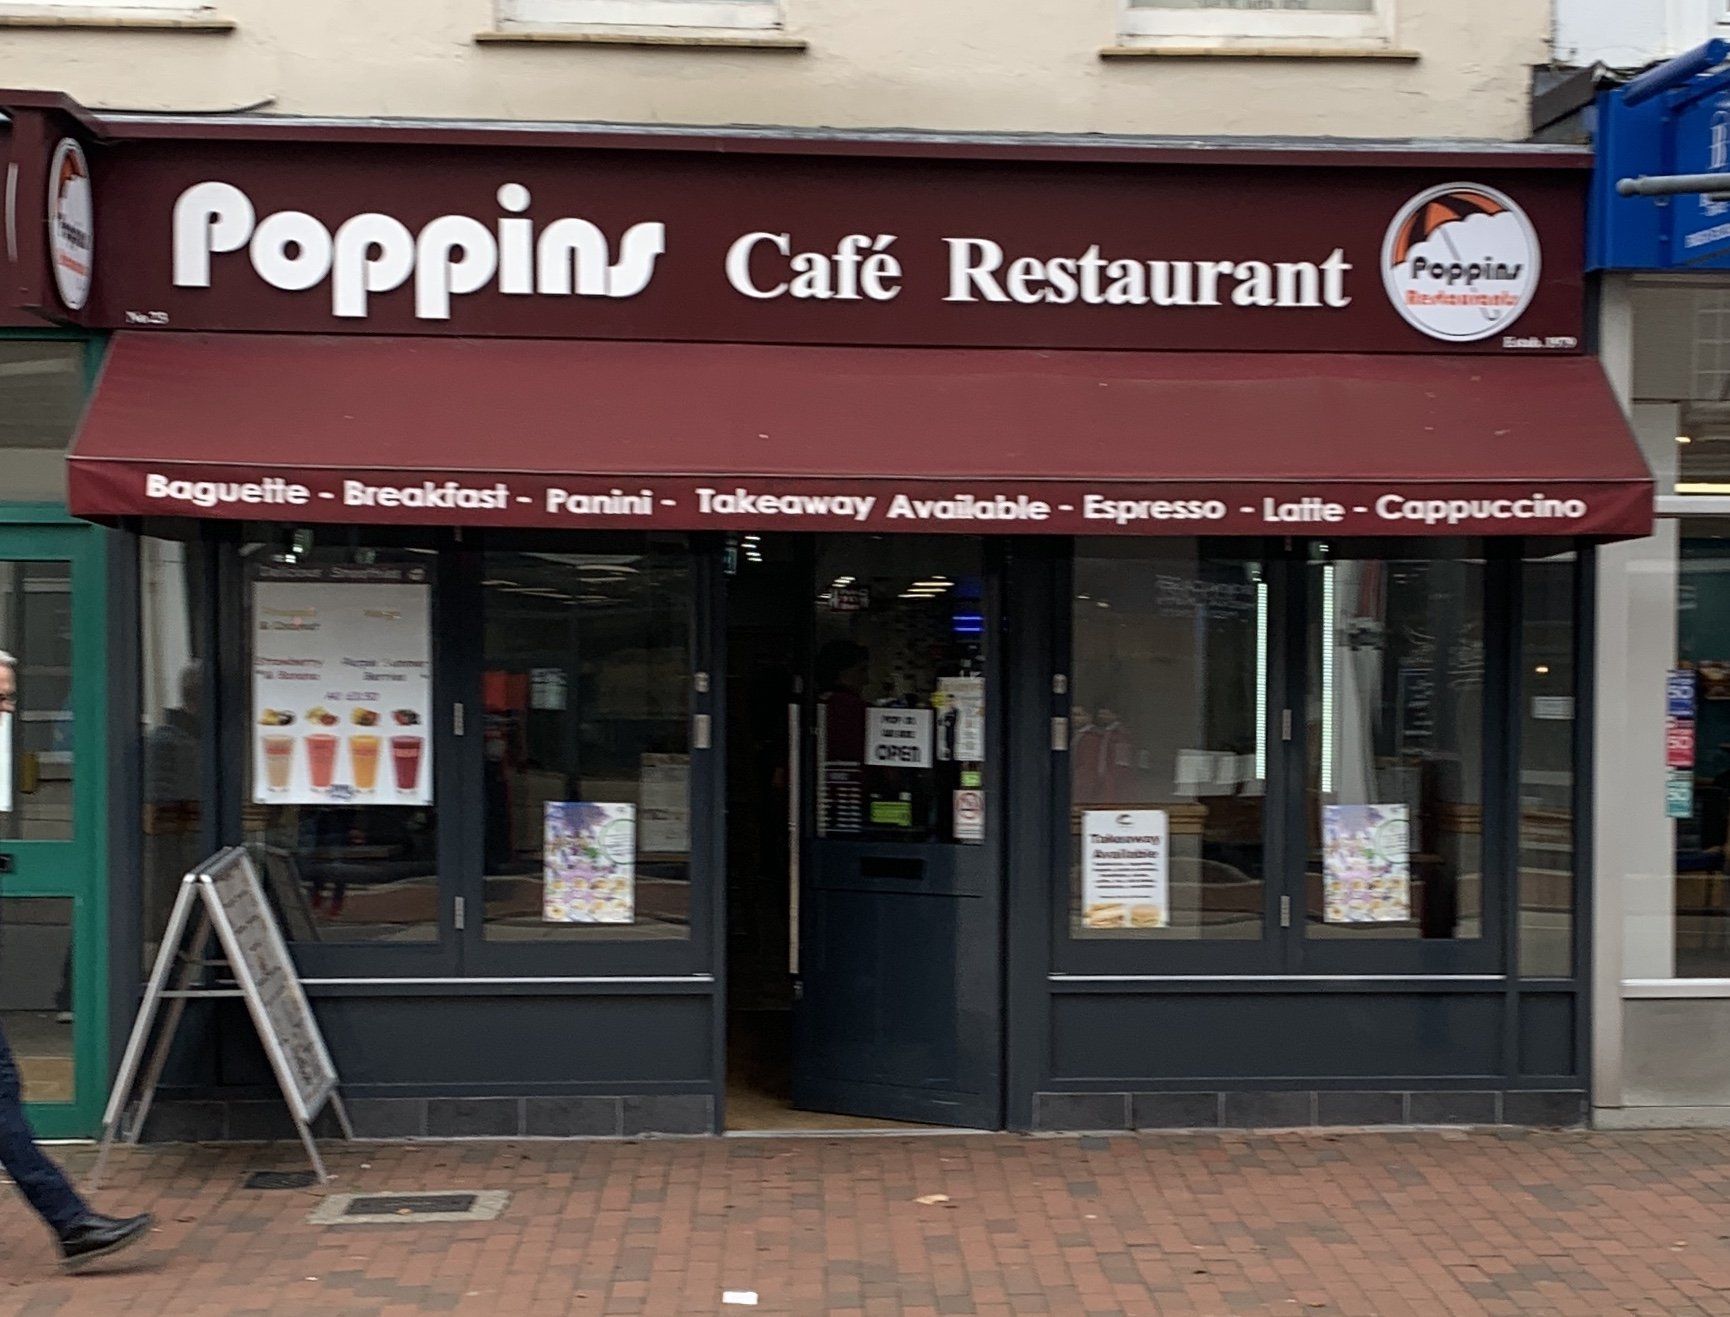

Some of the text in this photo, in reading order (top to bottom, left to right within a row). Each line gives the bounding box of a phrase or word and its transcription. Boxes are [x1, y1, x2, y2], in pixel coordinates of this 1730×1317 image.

[174, 182, 665, 320] Poppins
[726, 232, 902, 301] Café
[942, 237, 1352, 308] Restaurant
[1411, 256, 1523, 285] Poppins
[1405, 289, 1519, 305] Restaurants
[146, 474, 310, 507] Baguette
[344, 480, 510, 509] Breakfast
[547, 489, 653, 515] Panini
[696, 489, 876, 521] Takeaway
[887, 494, 1051, 520] Available
[1084, 494, 1226, 525] Espresso
[1263, 497, 1346, 522] Latte
[1376, 494, 1586, 525] Cappuccino
